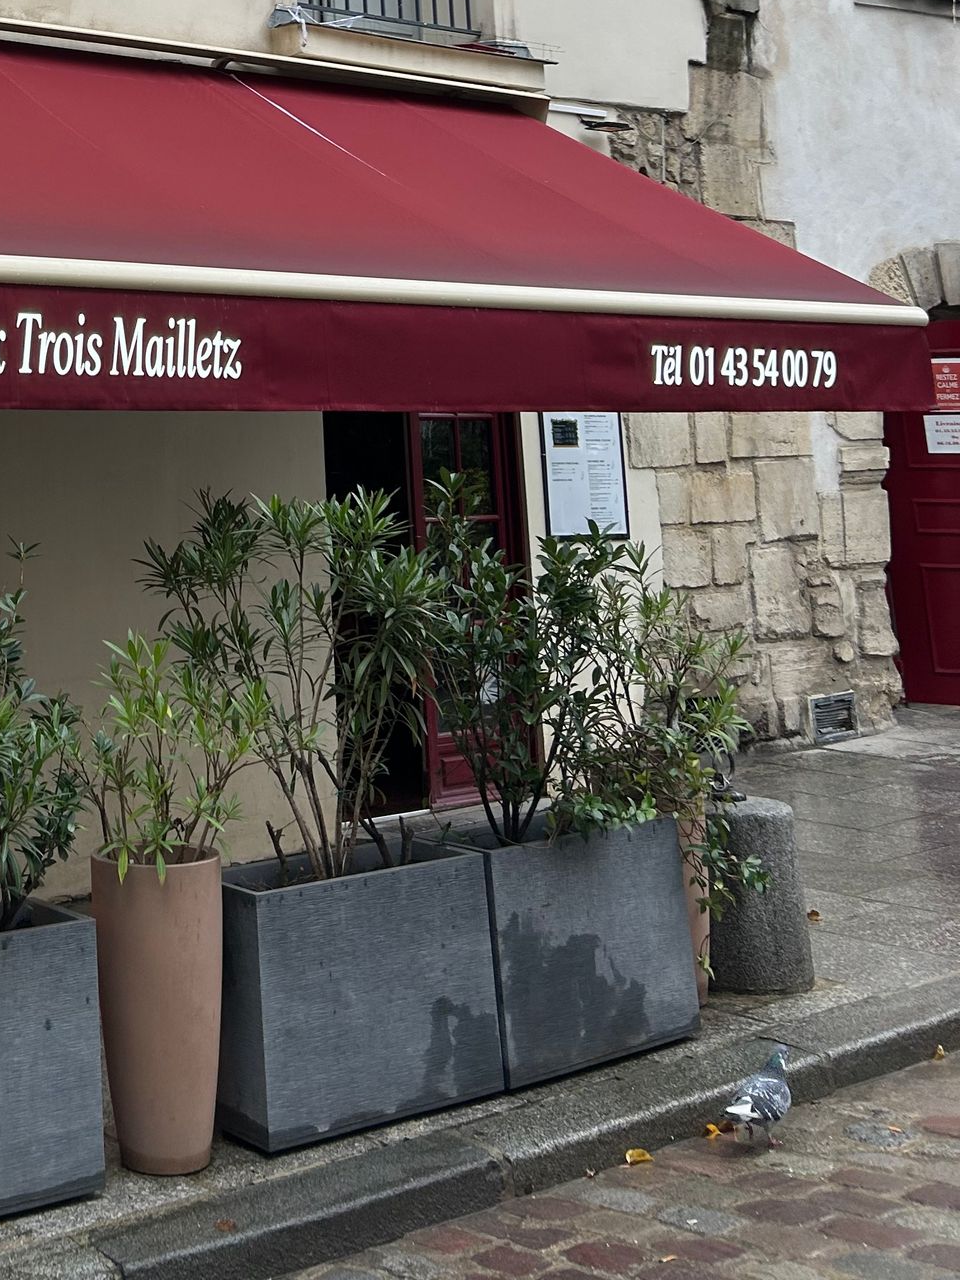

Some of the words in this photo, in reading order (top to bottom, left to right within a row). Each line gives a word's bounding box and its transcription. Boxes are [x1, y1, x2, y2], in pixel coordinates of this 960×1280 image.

[16, 312, 103, 376] Trois
[110, 316, 242, 380] Mailletz
[650, 344, 683, 386] Tél
[689, 345, 715, 386] 01
[720, 347, 747, 387] 43
[752, 348, 780, 387] 54
[782, 349, 809, 388] 00
[811, 350, 837, 388] 79
